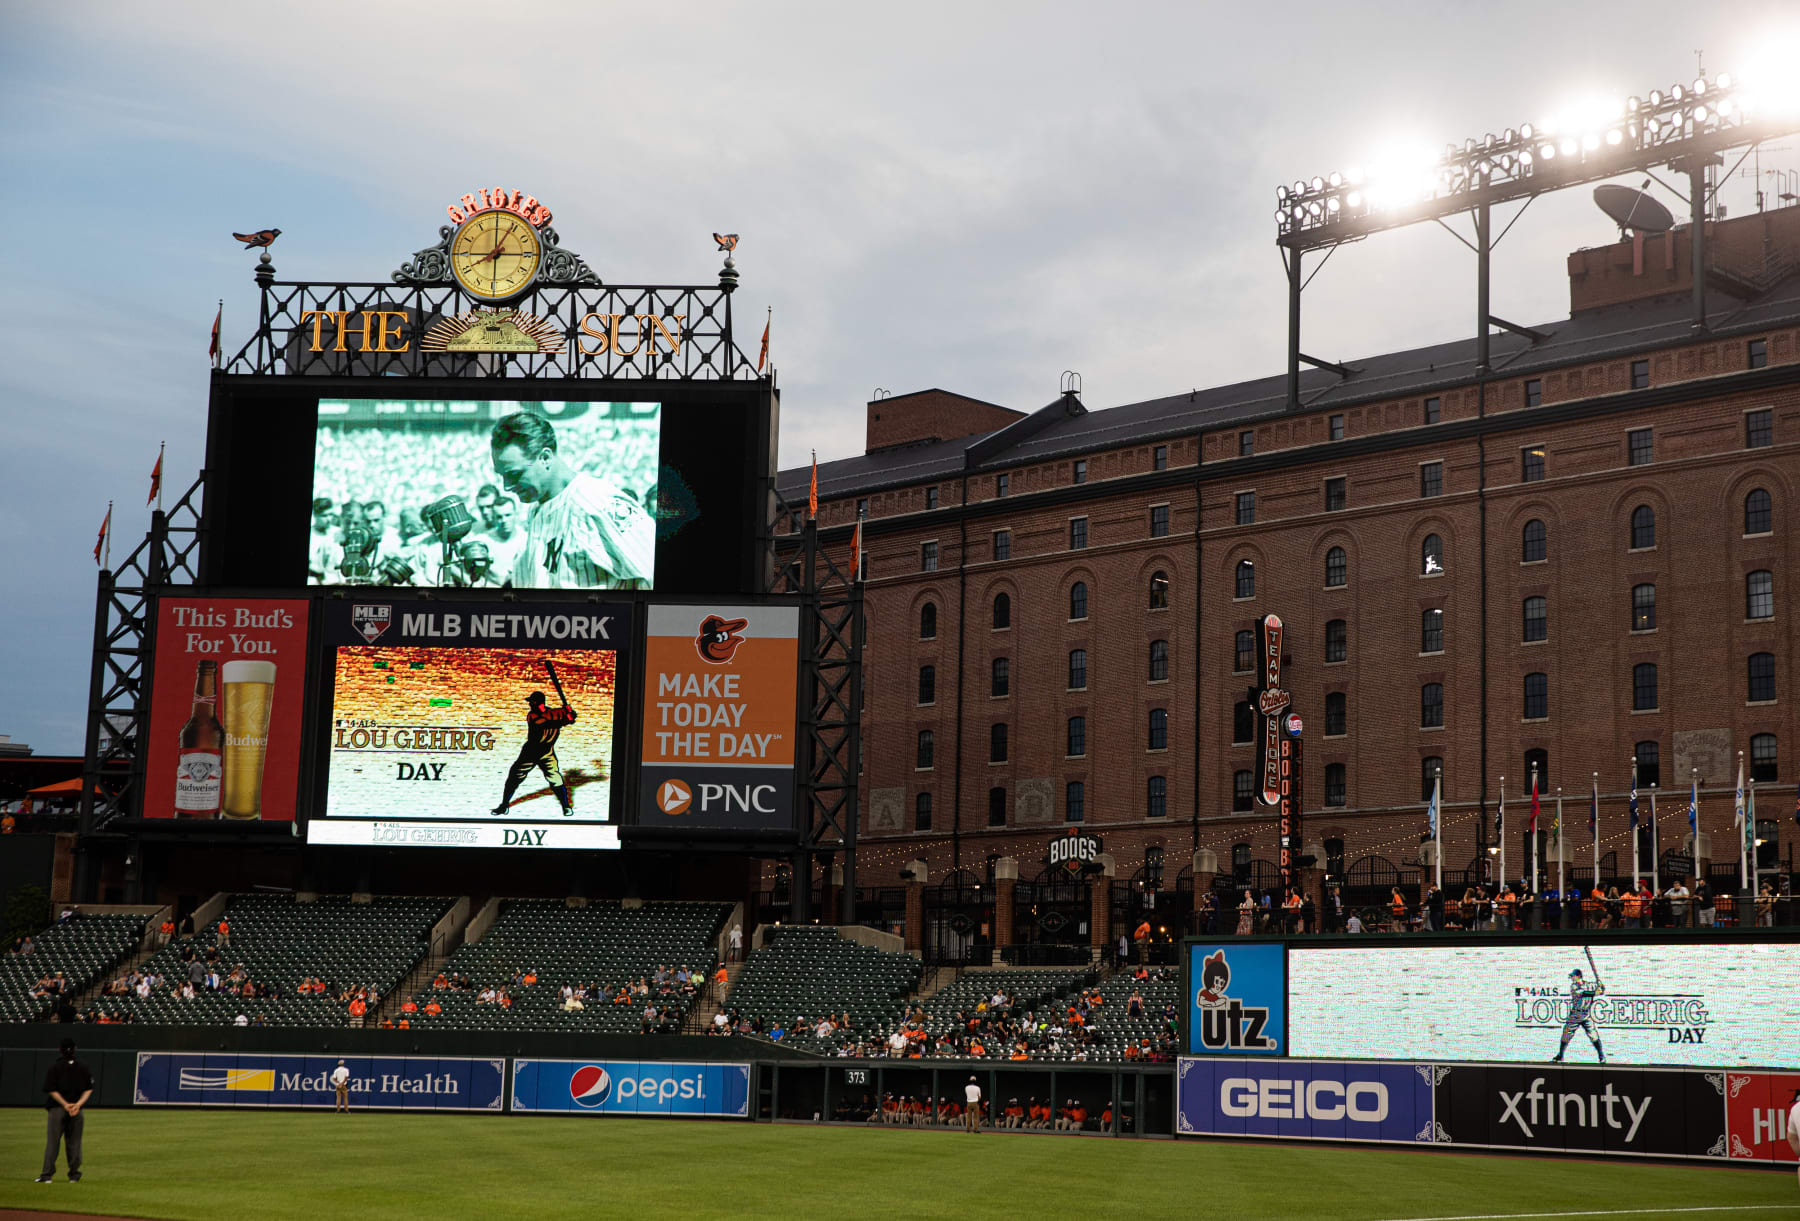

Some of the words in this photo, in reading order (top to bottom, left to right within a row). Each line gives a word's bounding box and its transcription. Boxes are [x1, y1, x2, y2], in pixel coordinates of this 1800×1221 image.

[447, 186, 553, 229] ORIOLES
[301, 311, 410, 353] THE
[579, 313, 687, 357] SUN
[172, 606, 227, 628] This
[233, 607, 294, 629] Bud's
[355, 606, 389, 618] MLB
[401, 613, 462, 638] MLB
[470, 614, 611, 640] NETWORK
[184, 632, 225, 654] For
[228, 633, 278, 655] You.
[1267, 629, 1279, 685] TEAM
[658, 672, 741, 698] MAKE
[1260, 690, 1290, 711] Orioles
[656, 702, 748, 728] TODAY
[334, 728, 389, 749] LOU
[393, 730, 496, 751] GEHRIG
[655, 732, 711, 757] THE
[718, 733, 772, 758] DAY
[1266, 719, 1278, 788] STORE
[396, 762, 447, 781] DAY
[177, 783, 219, 793] Budweiser
[697, 783, 777, 813] PNC
[372, 827, 409, 842] LOU
[411, 828, 478, 844] GEHRIG
[502, 829, 548, 846] DAY
[1050, 836, 1097, 865] BOOG'S
[1590, 998, 1710, 1026] GEHRIG
[1667, 1027, 1706, 1044] DAY
[379, 1072, 459, 1094] Health
[617, 1073, 703, 1105] pepsi
[848, 1071, 865, 1084] 373
[1220, 1077, 1389, 1123] GEICO
[1497, 1077, 1653, 1143] xfinity
